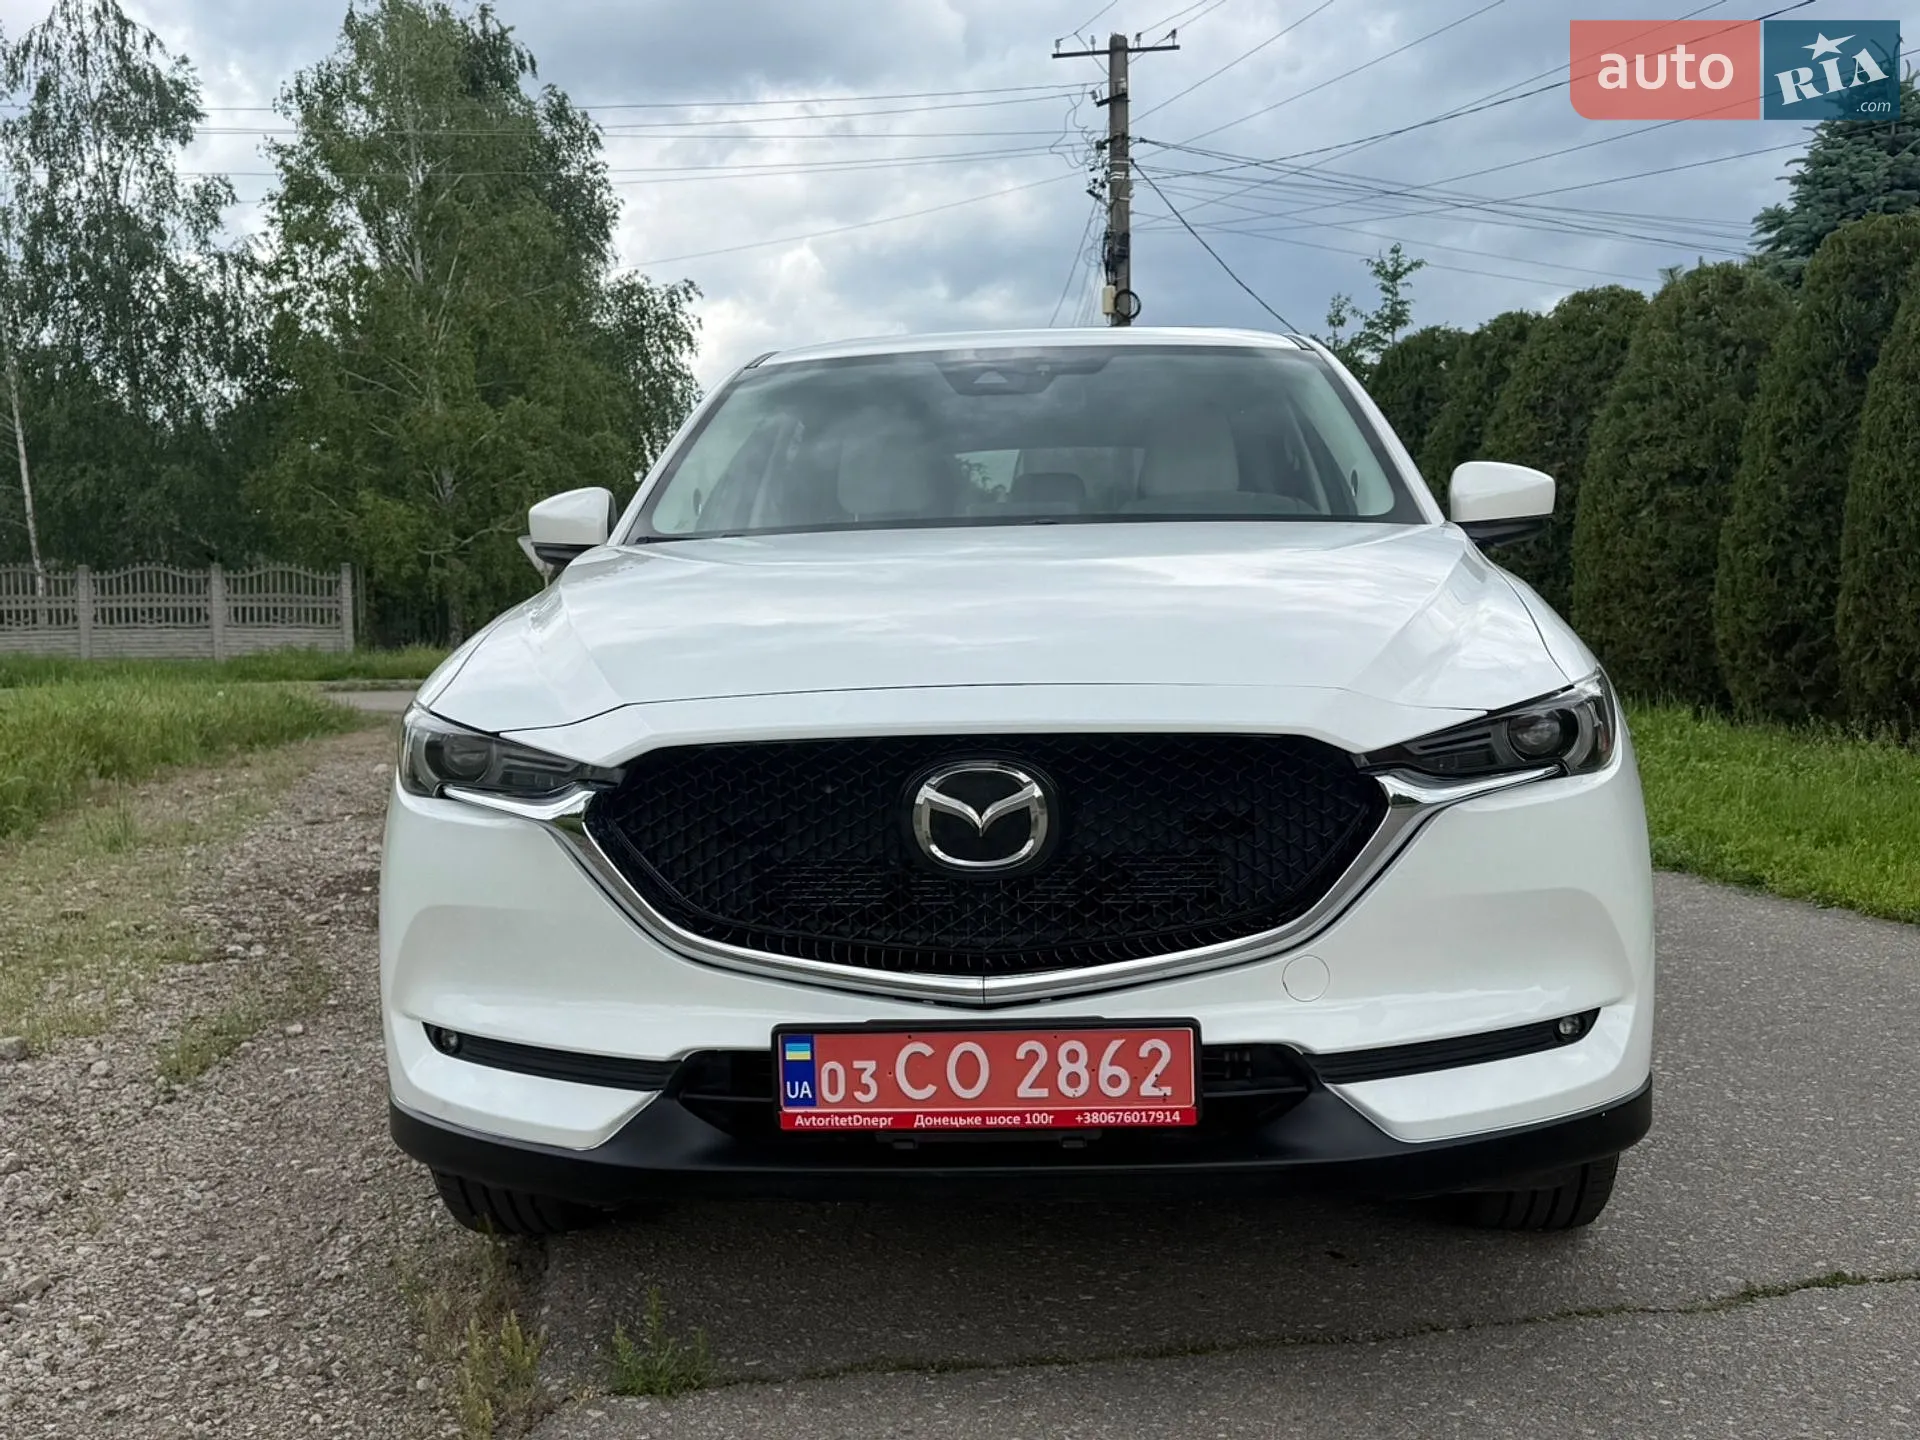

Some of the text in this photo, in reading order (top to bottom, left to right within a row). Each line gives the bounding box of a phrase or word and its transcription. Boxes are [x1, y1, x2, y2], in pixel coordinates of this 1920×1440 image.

[820, 1038, 1172, 1103] 03 CO 2862
[786, 1081, 813, 1099] UA
[794, 1111, 1181, 1128] AvtoritetDnepr Донецьке шосе 100г +380676017914
